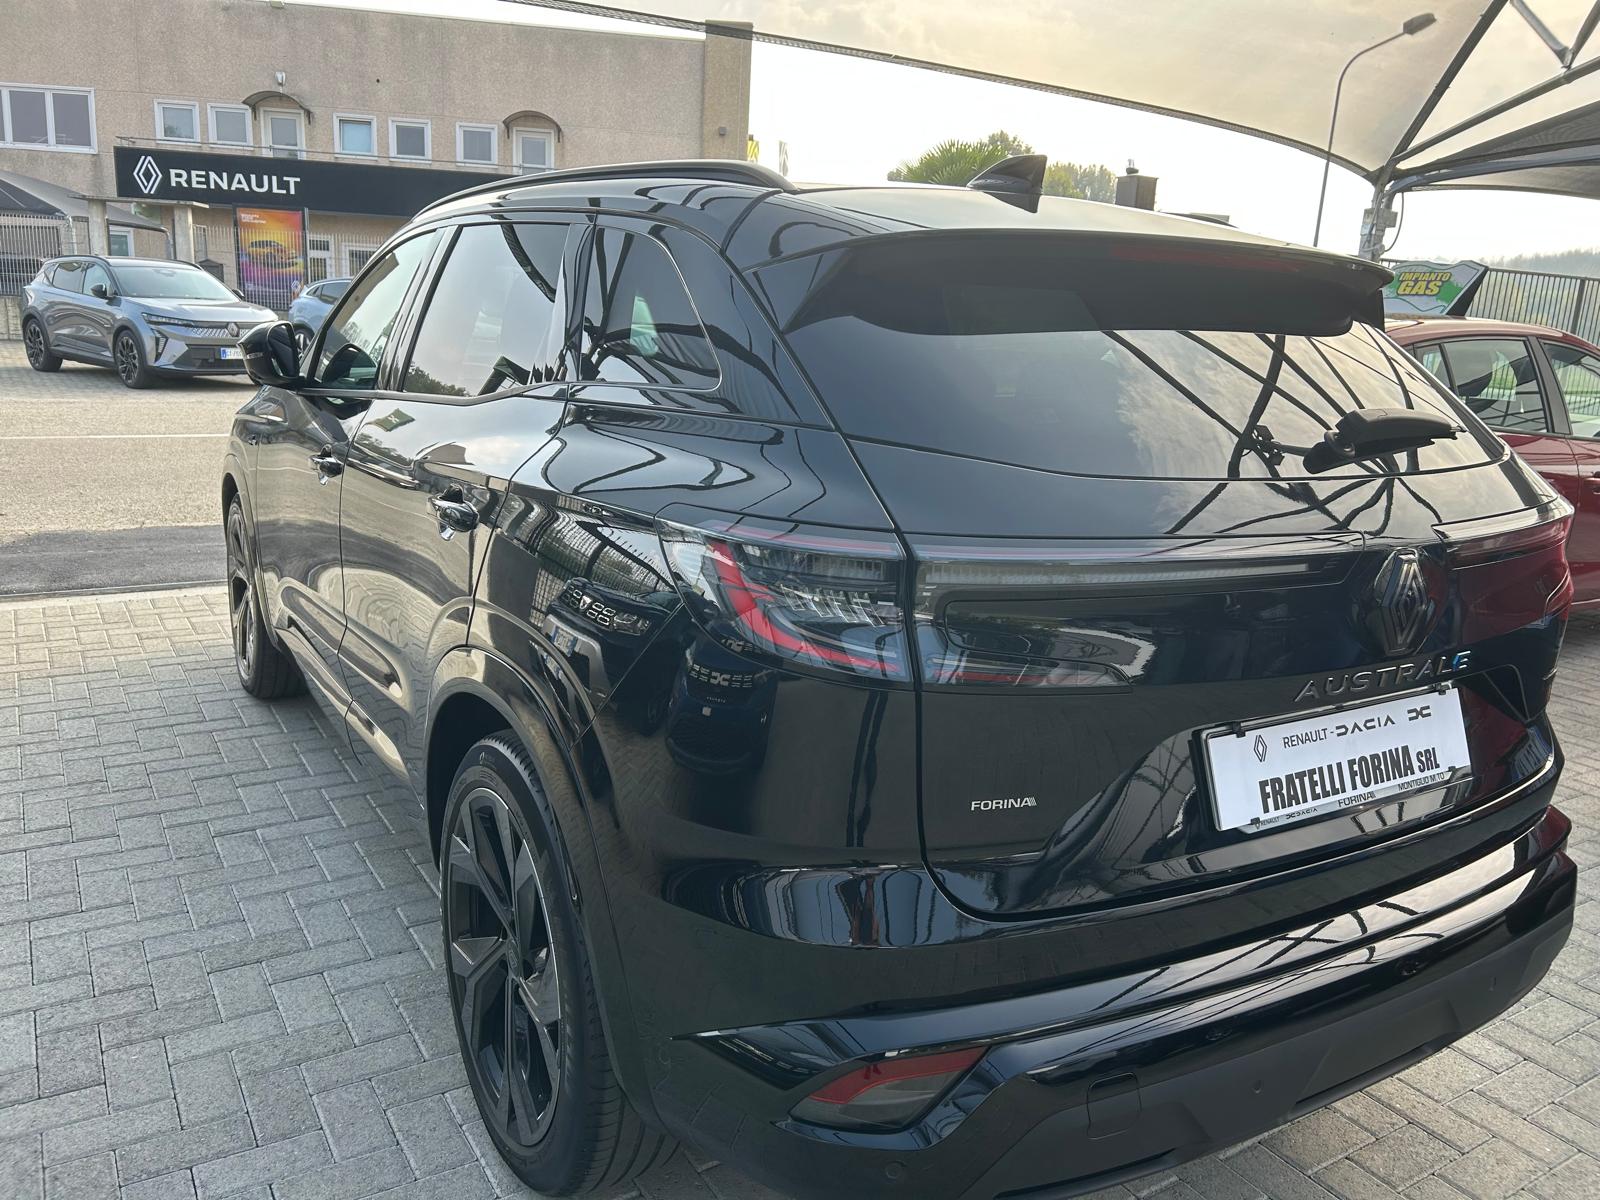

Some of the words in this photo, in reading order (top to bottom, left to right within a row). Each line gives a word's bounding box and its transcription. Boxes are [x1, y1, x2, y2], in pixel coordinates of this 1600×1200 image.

[169, 168, 301, 195] RENAULT
[1397, 281, 1441, 295] GAS
[1399, 271, 1451, 281] IMPIANTO
[1294, 650, 1471, 702] AUSTRALE
[1283, 728, 1328, 749] RENAULT
[1336, 714, 1396, 737] DACIA
[1258, 761, 1347, 814] FRATELLI
[1347, 745, 1416, 791] FORINA
[1416, 747, 1440, 773] SRL
[971, 797, 1034, 811] FORINA
[1260, 815, 1281, 826] RENAULT
[1338, 791, 1374, 808] FORINA
